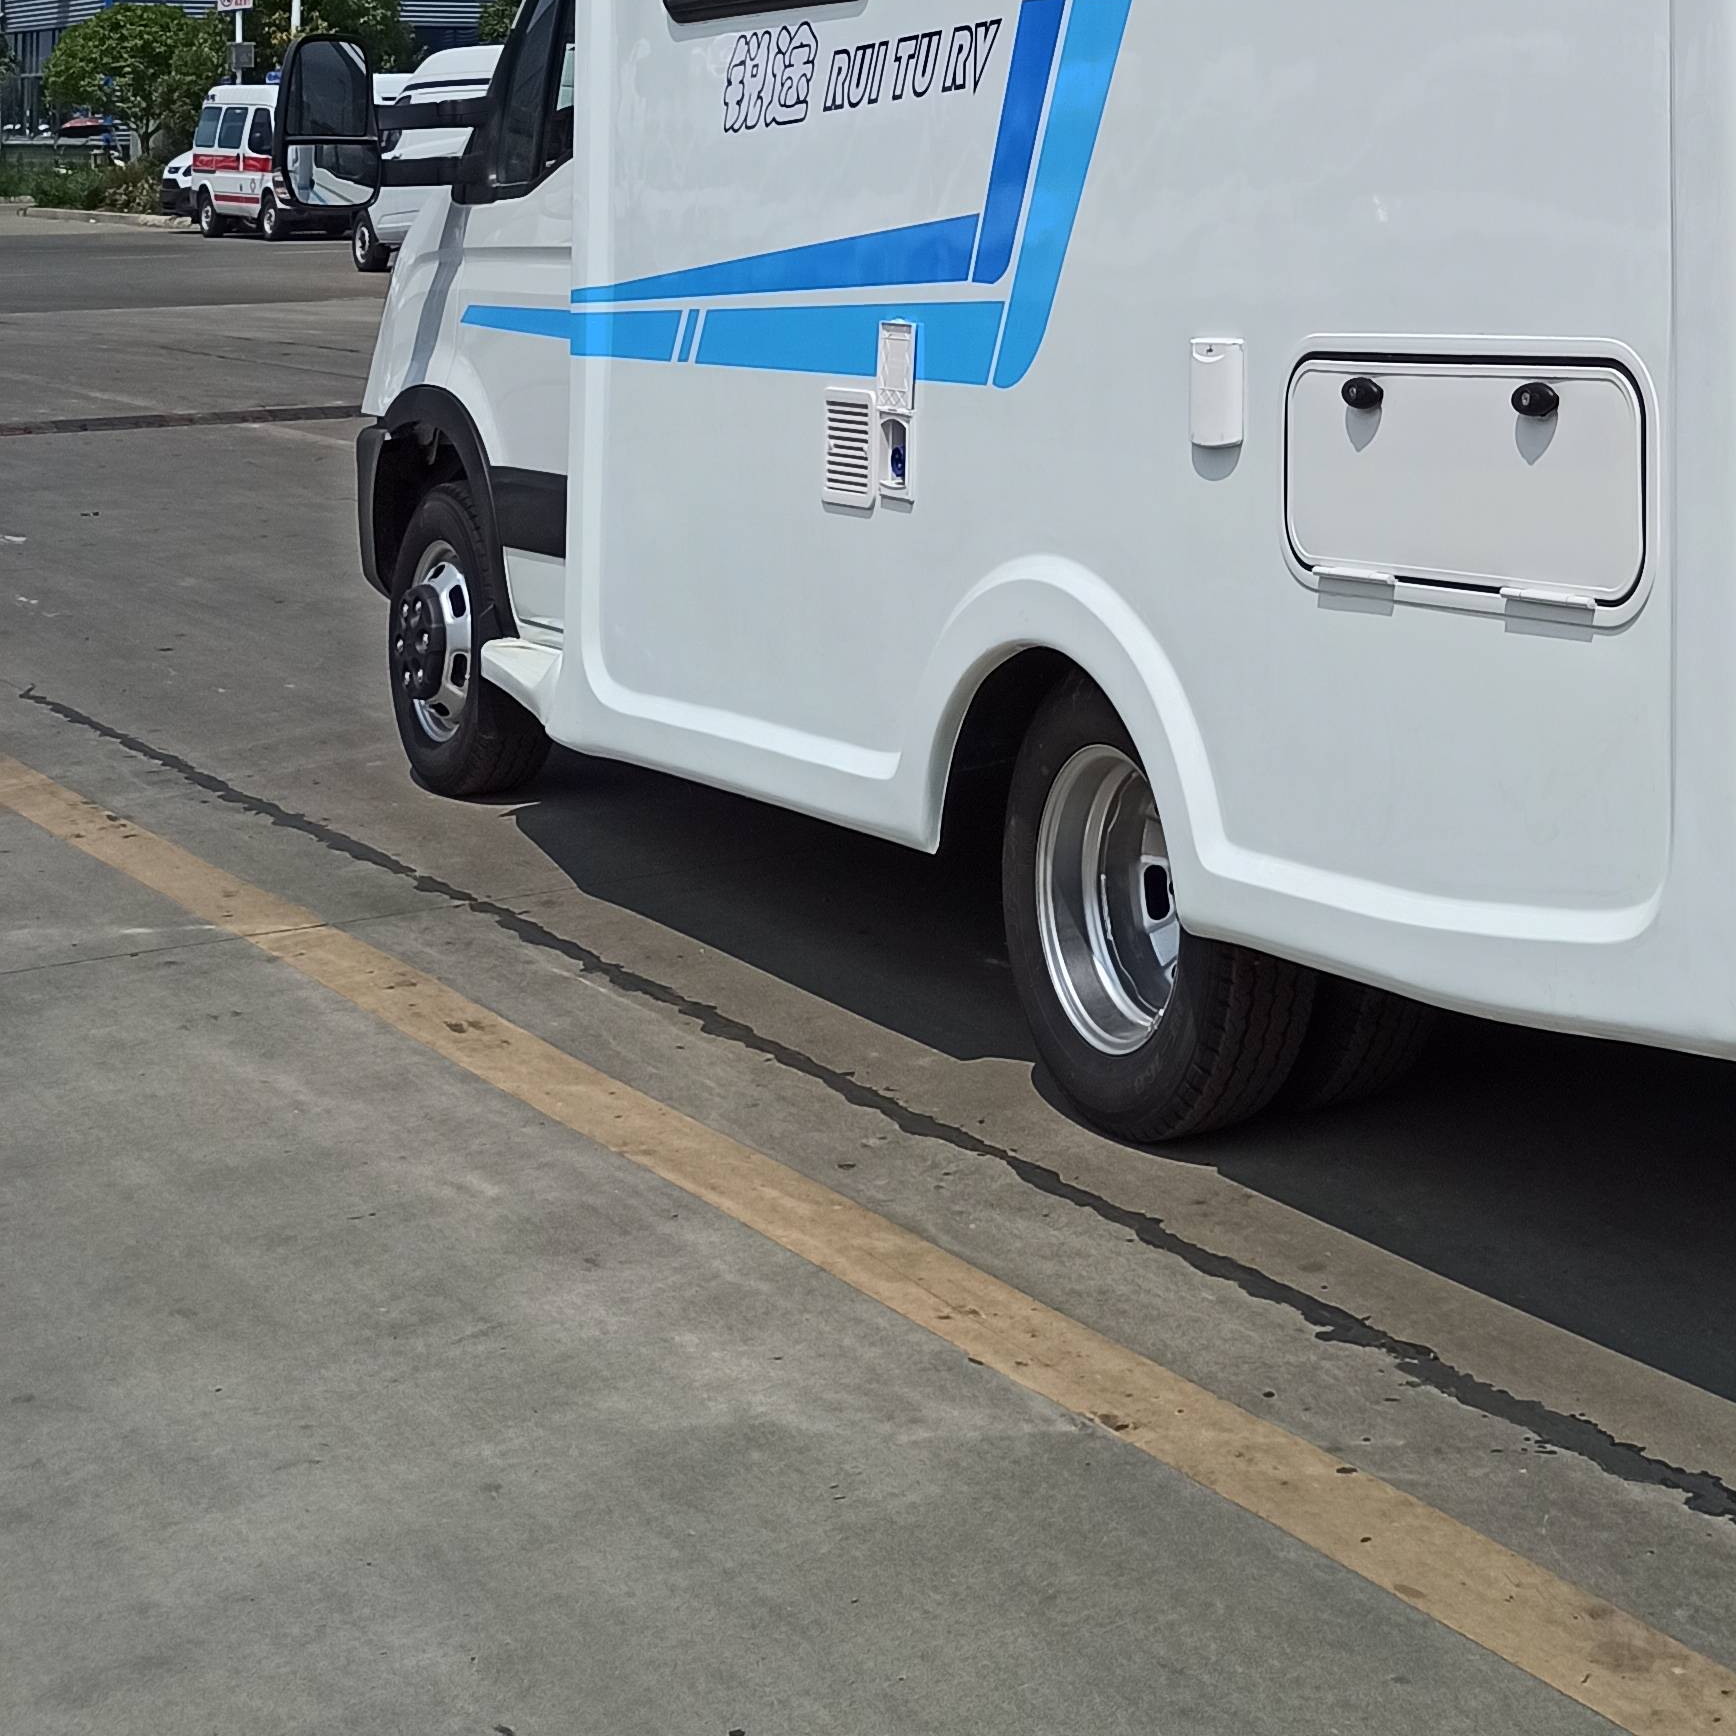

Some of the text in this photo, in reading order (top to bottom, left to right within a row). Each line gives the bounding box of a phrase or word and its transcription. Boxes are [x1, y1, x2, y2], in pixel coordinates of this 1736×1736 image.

[723, 18, 1002, 133] 锐途 RUI TU RV
